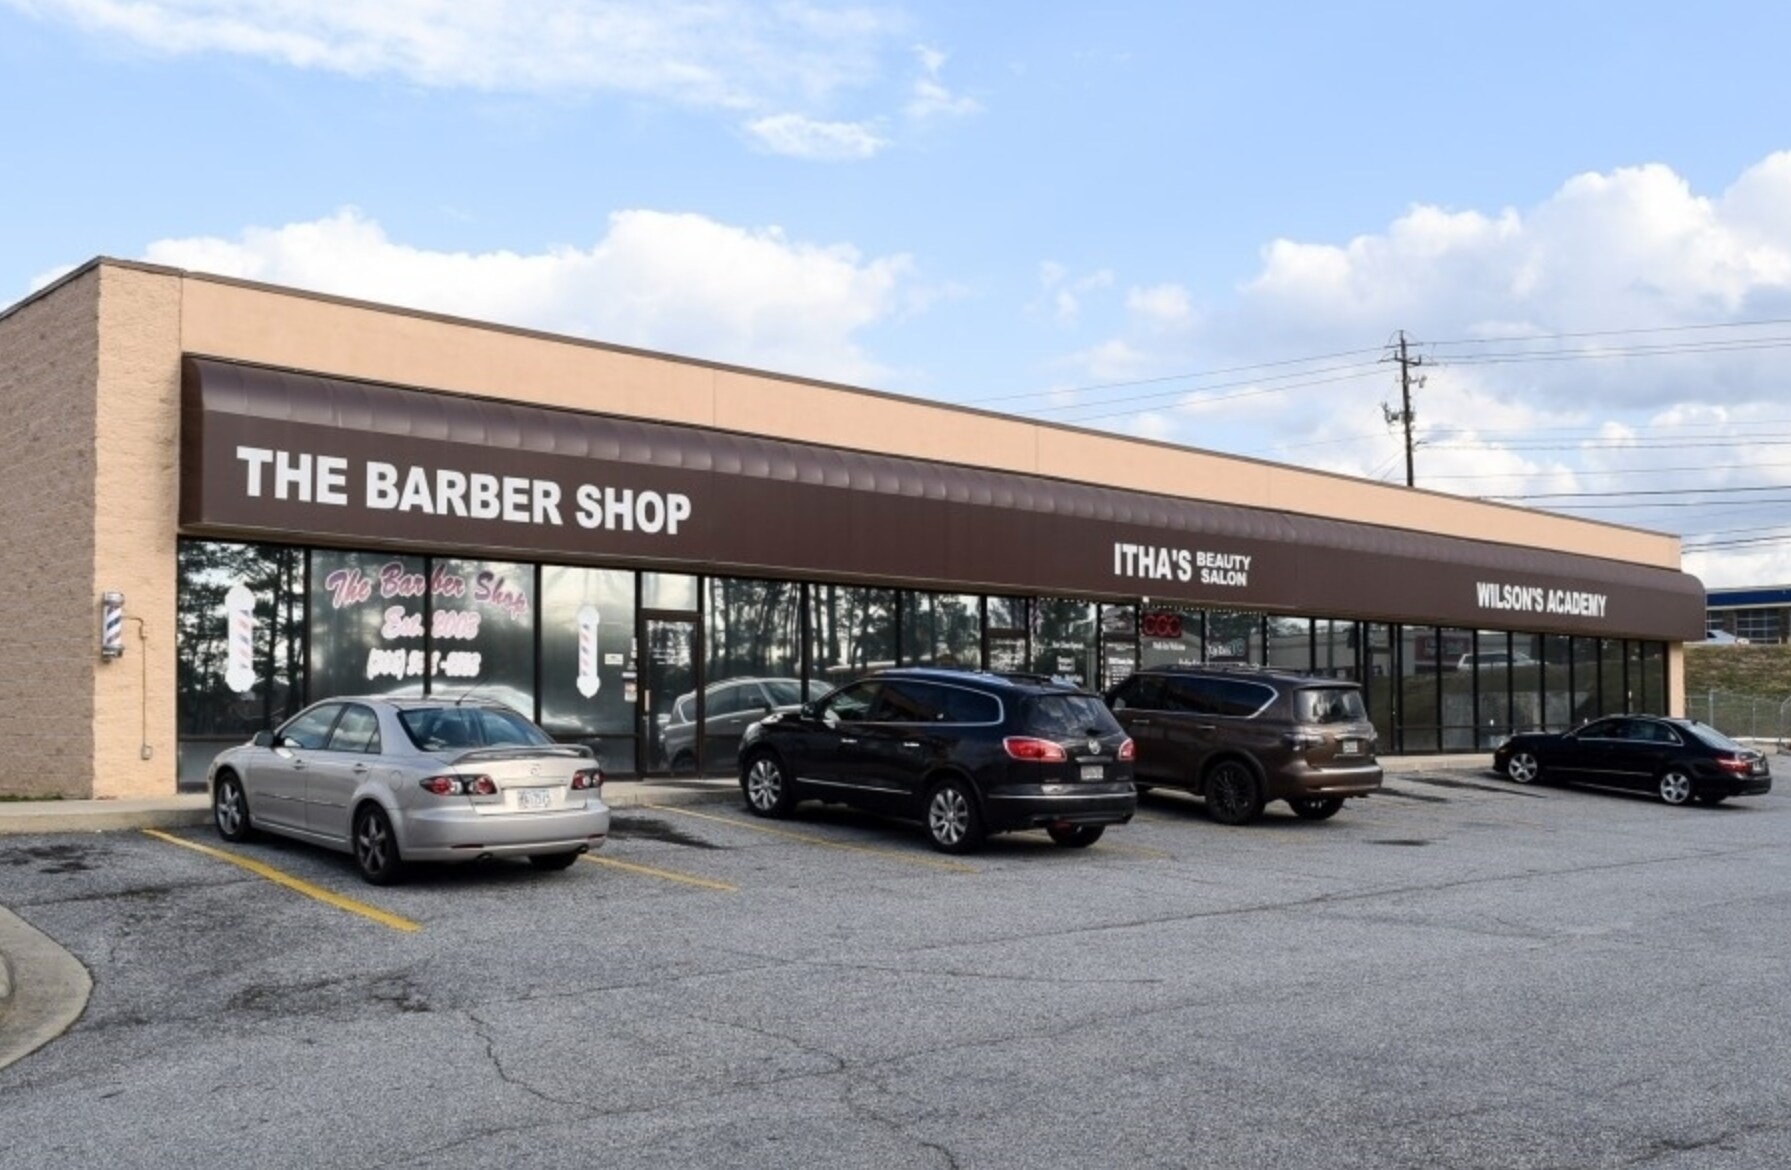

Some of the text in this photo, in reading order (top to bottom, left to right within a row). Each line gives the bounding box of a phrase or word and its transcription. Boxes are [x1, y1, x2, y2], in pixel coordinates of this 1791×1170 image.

[236, 445, 692, 535] THE BARBER SHOP
[1114, 542, 1193, 582] ITHA'S
[1196, 551, 1251, 570] BEAUTY
[1200, 567, 1248, 587] SALON
[325, 567, 373, 609] The
[474, 570, 529, 620] Shop
[1476, 581, 1608, 617] WILSON'S ACADEMY
